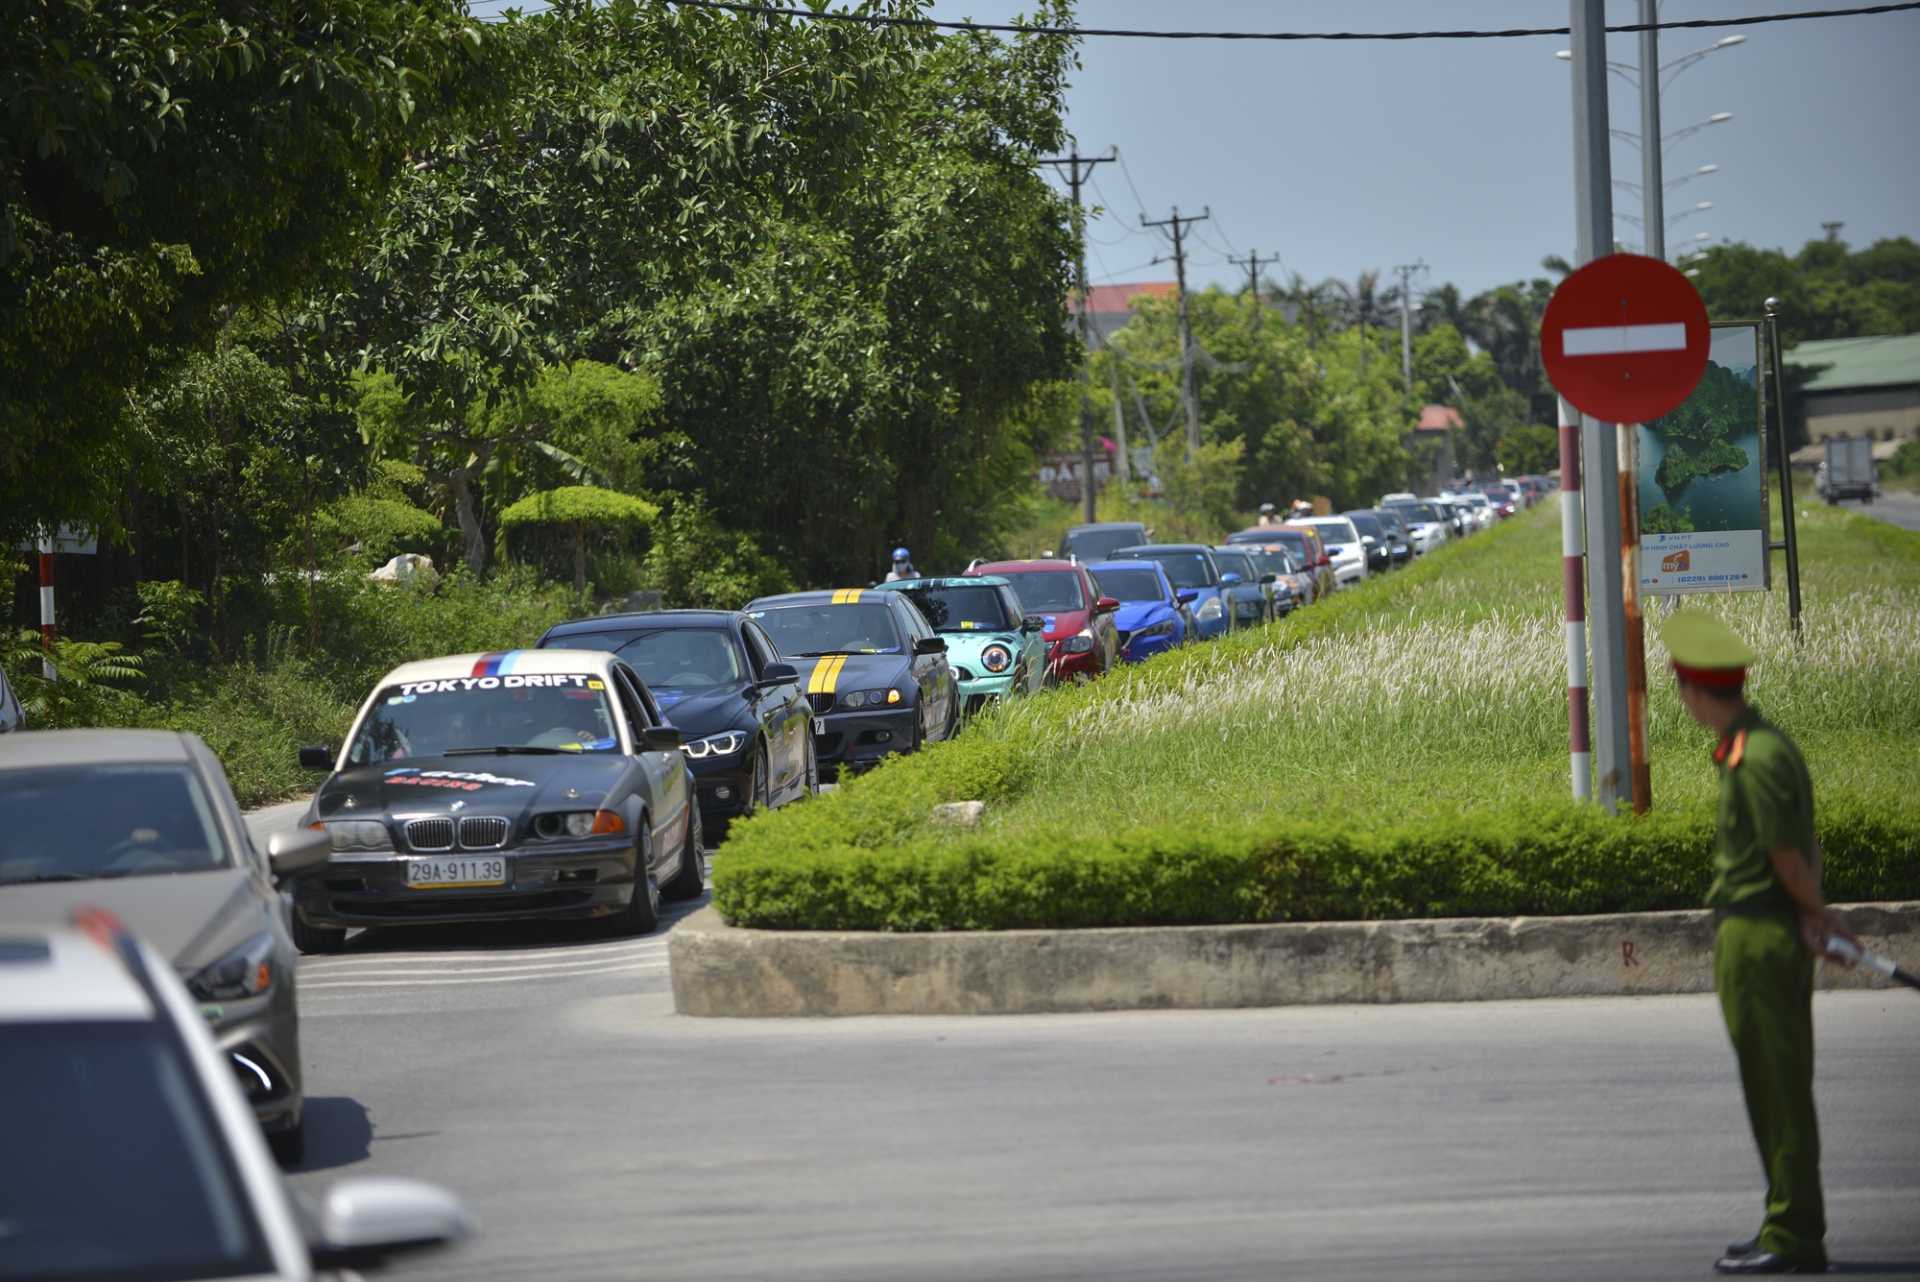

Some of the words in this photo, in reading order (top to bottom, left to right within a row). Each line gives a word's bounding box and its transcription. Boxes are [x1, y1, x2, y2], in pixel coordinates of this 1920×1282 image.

[1669, 541, 1688, 550] CHẤT
[401, 677, 500, 696] TOKYO
[504, 675, 588, 688] DRIFT
[411, 861, 502, 881] 29A-911.39
[1622, 941, 1639, 967] R
